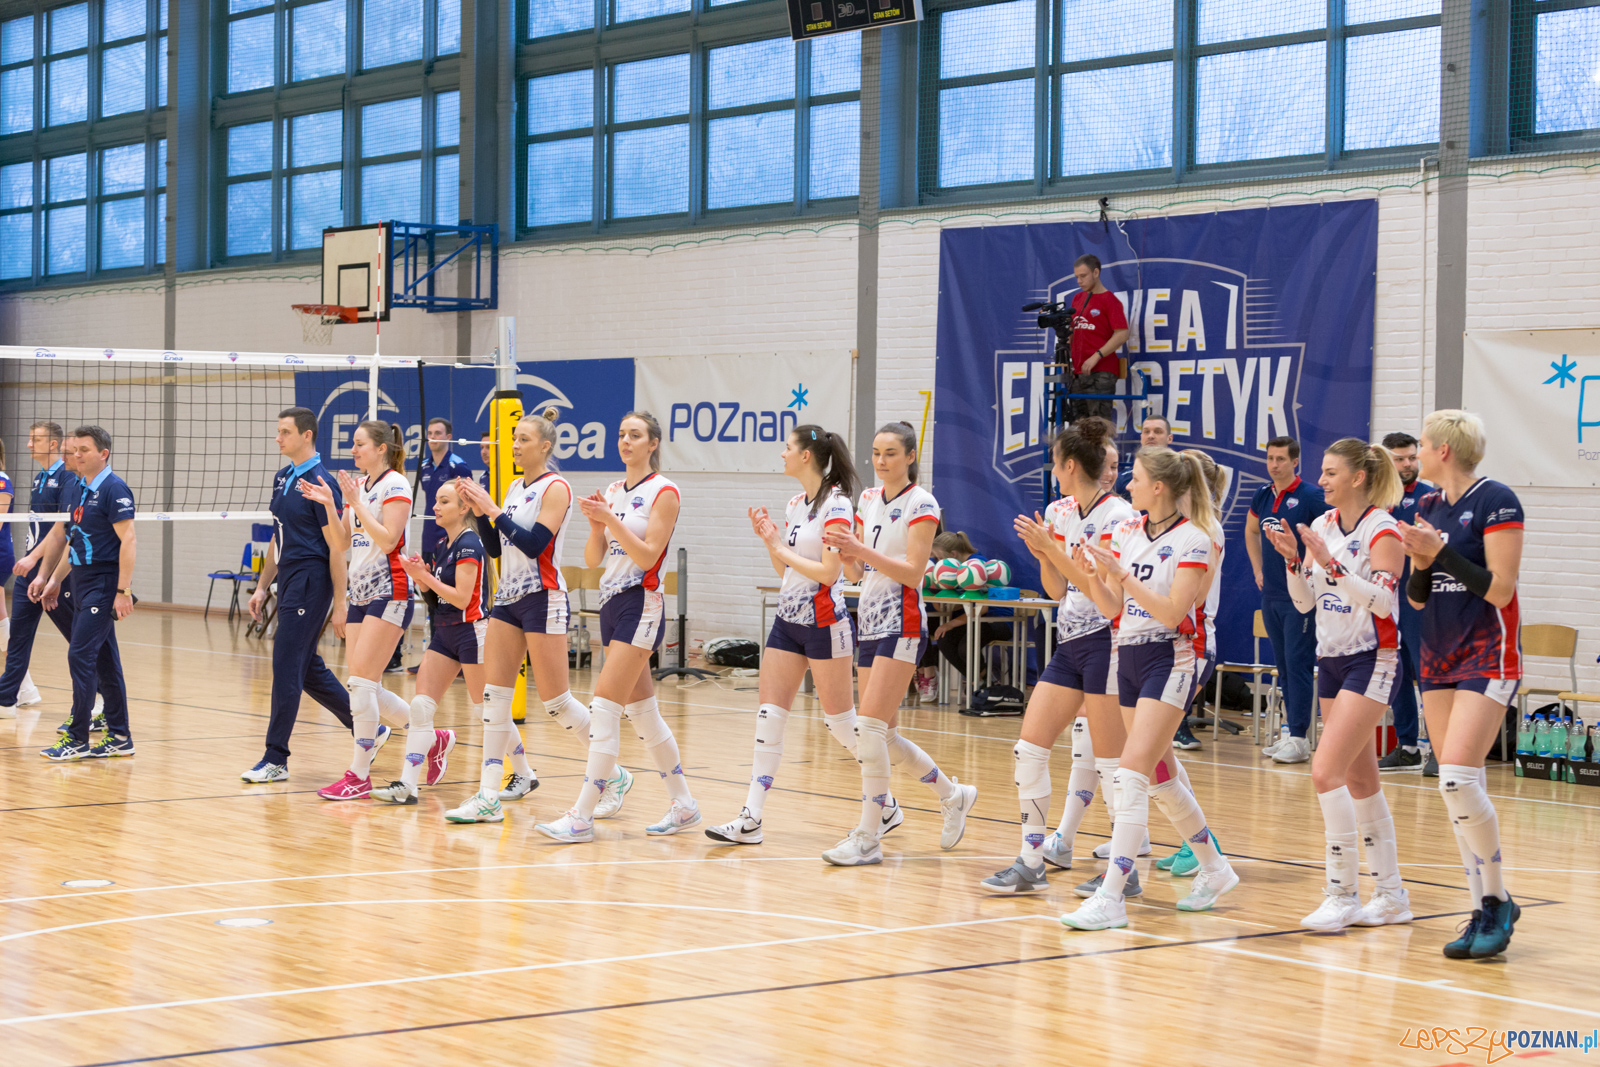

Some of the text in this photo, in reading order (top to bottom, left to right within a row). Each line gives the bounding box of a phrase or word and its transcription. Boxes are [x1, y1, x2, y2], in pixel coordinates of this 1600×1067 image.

[873, 9, 900, 19] STAN SETÓW
[806, 21, 831, 31] STAN SETÓW
[1114, 288, 1206, 352] NEA
[1003, 356, 1292, 456] ENGETYK
[331, 413, 426, 460] Ea
[789, 525, 801, 546] 5
[873, 525, 882, 549] 7
[353, 539, 370, 547] Enea
[1323, 600, 1352, 613] Enea
[1526, 762, 1545, 770] SELECT
[1579, 768, 1600, 777] SELECT
